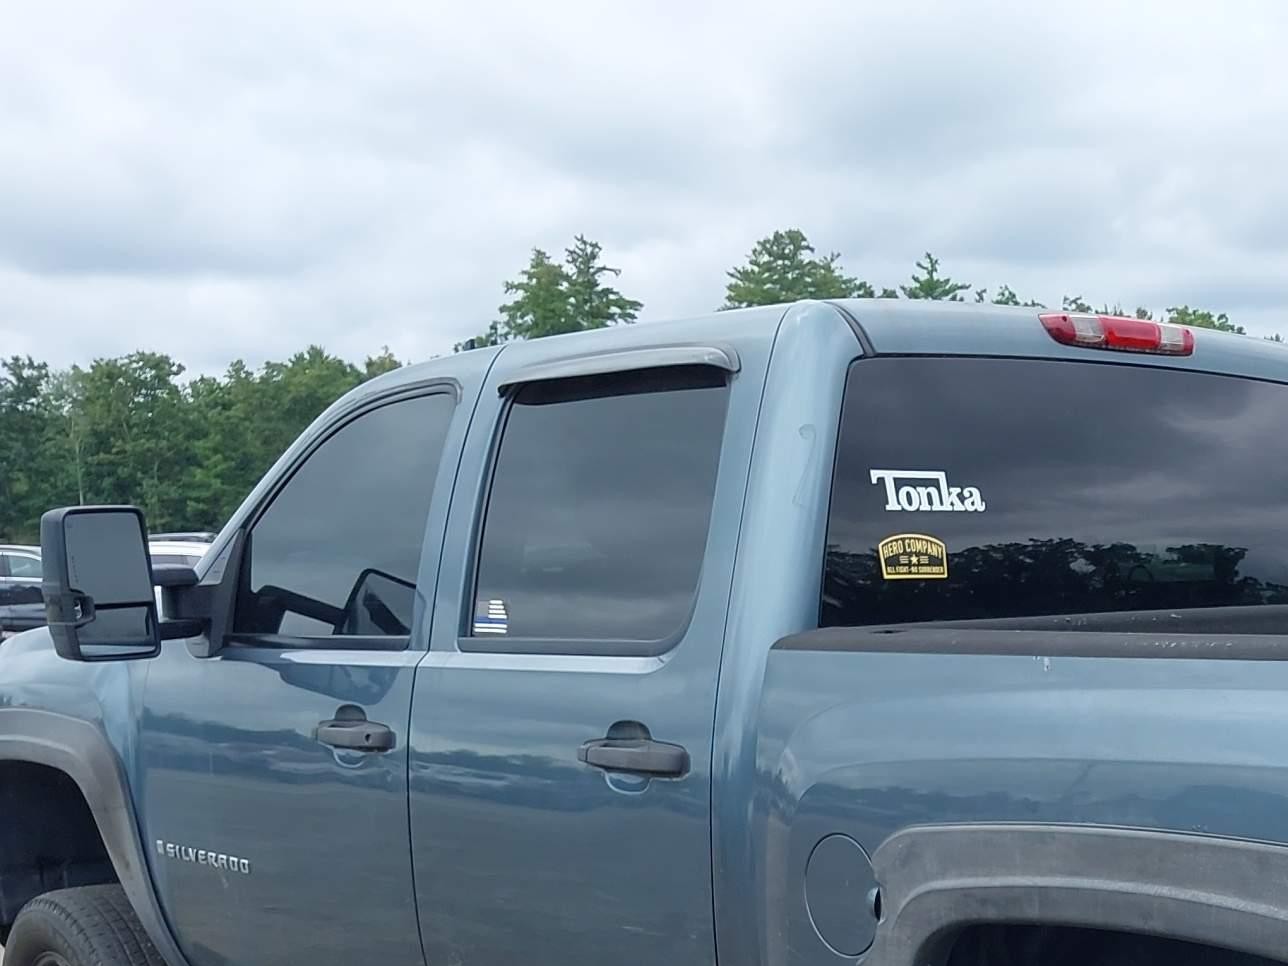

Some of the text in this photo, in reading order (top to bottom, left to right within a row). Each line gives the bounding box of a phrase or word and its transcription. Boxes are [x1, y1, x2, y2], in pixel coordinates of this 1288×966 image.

[870, 469, 986, 512] Tonka
[882, 539, 943, 560] HERO COMPANY
[166, 843, 249, 874] SILVERADO
